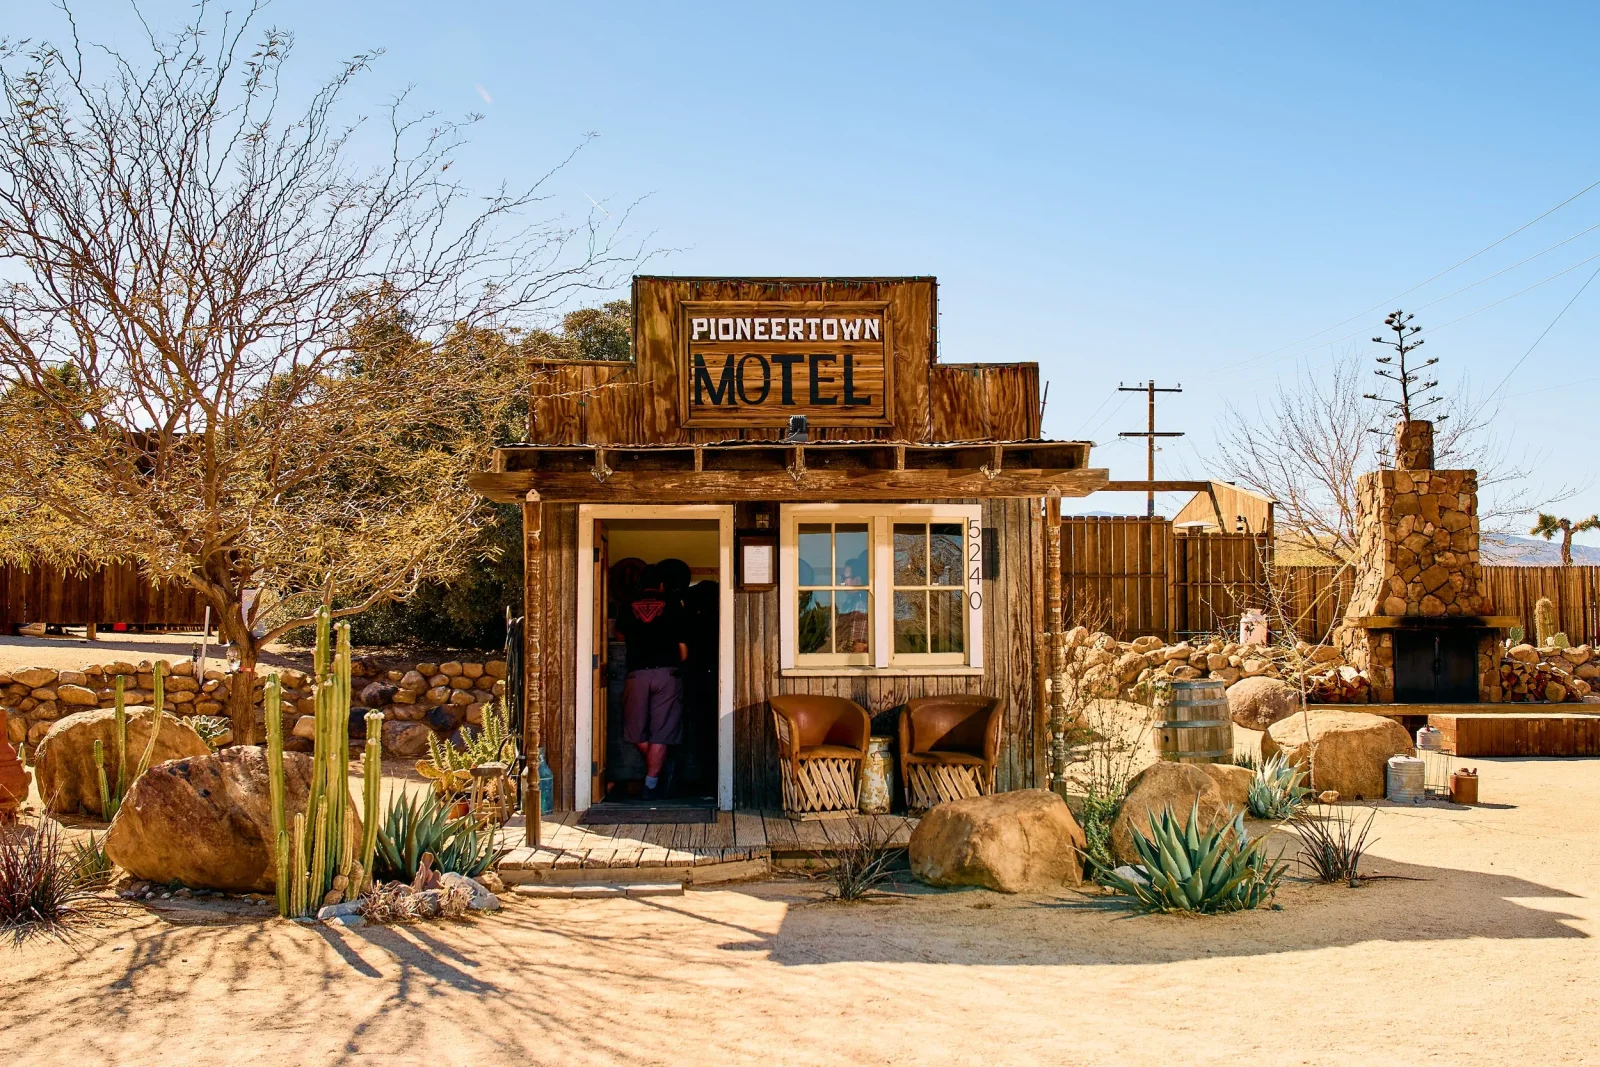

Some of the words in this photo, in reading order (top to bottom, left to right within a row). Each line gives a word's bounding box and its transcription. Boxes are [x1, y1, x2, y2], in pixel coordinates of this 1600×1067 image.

[691, 318, 880, 341] PIONEERTOWN
[694, 354, 872, 405] MOTEL
[969, 519, 982, 610] 5240
